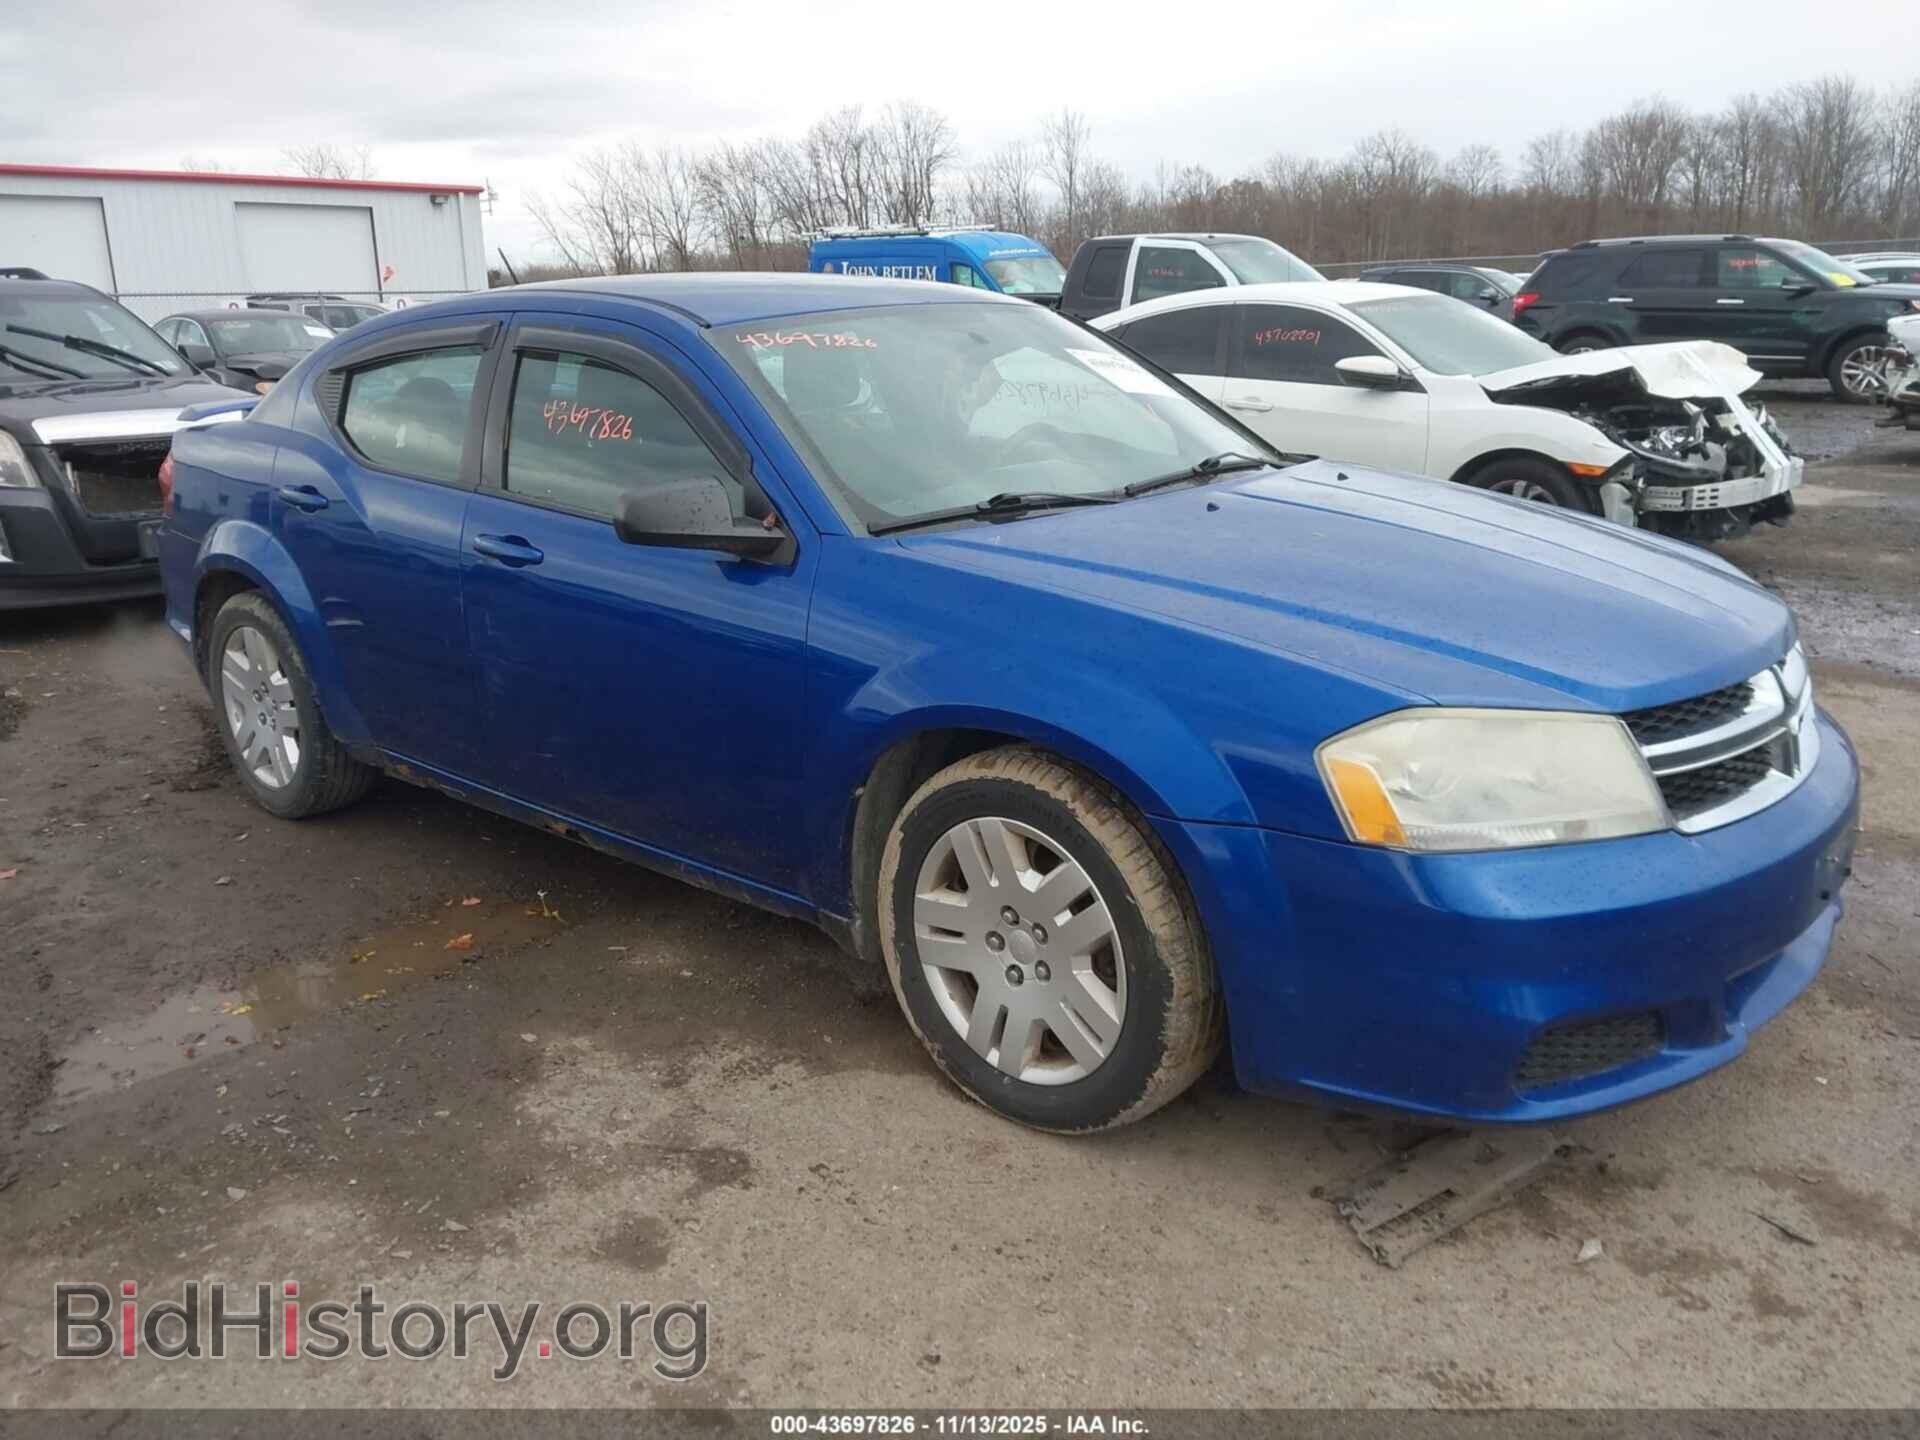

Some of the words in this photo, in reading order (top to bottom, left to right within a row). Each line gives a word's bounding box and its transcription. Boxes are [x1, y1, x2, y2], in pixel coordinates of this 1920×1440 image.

[841, 261, 878, 279] JOHN
[735, 331, 878, 349] 43697826
[543, 399, 633, 440] 43697826
